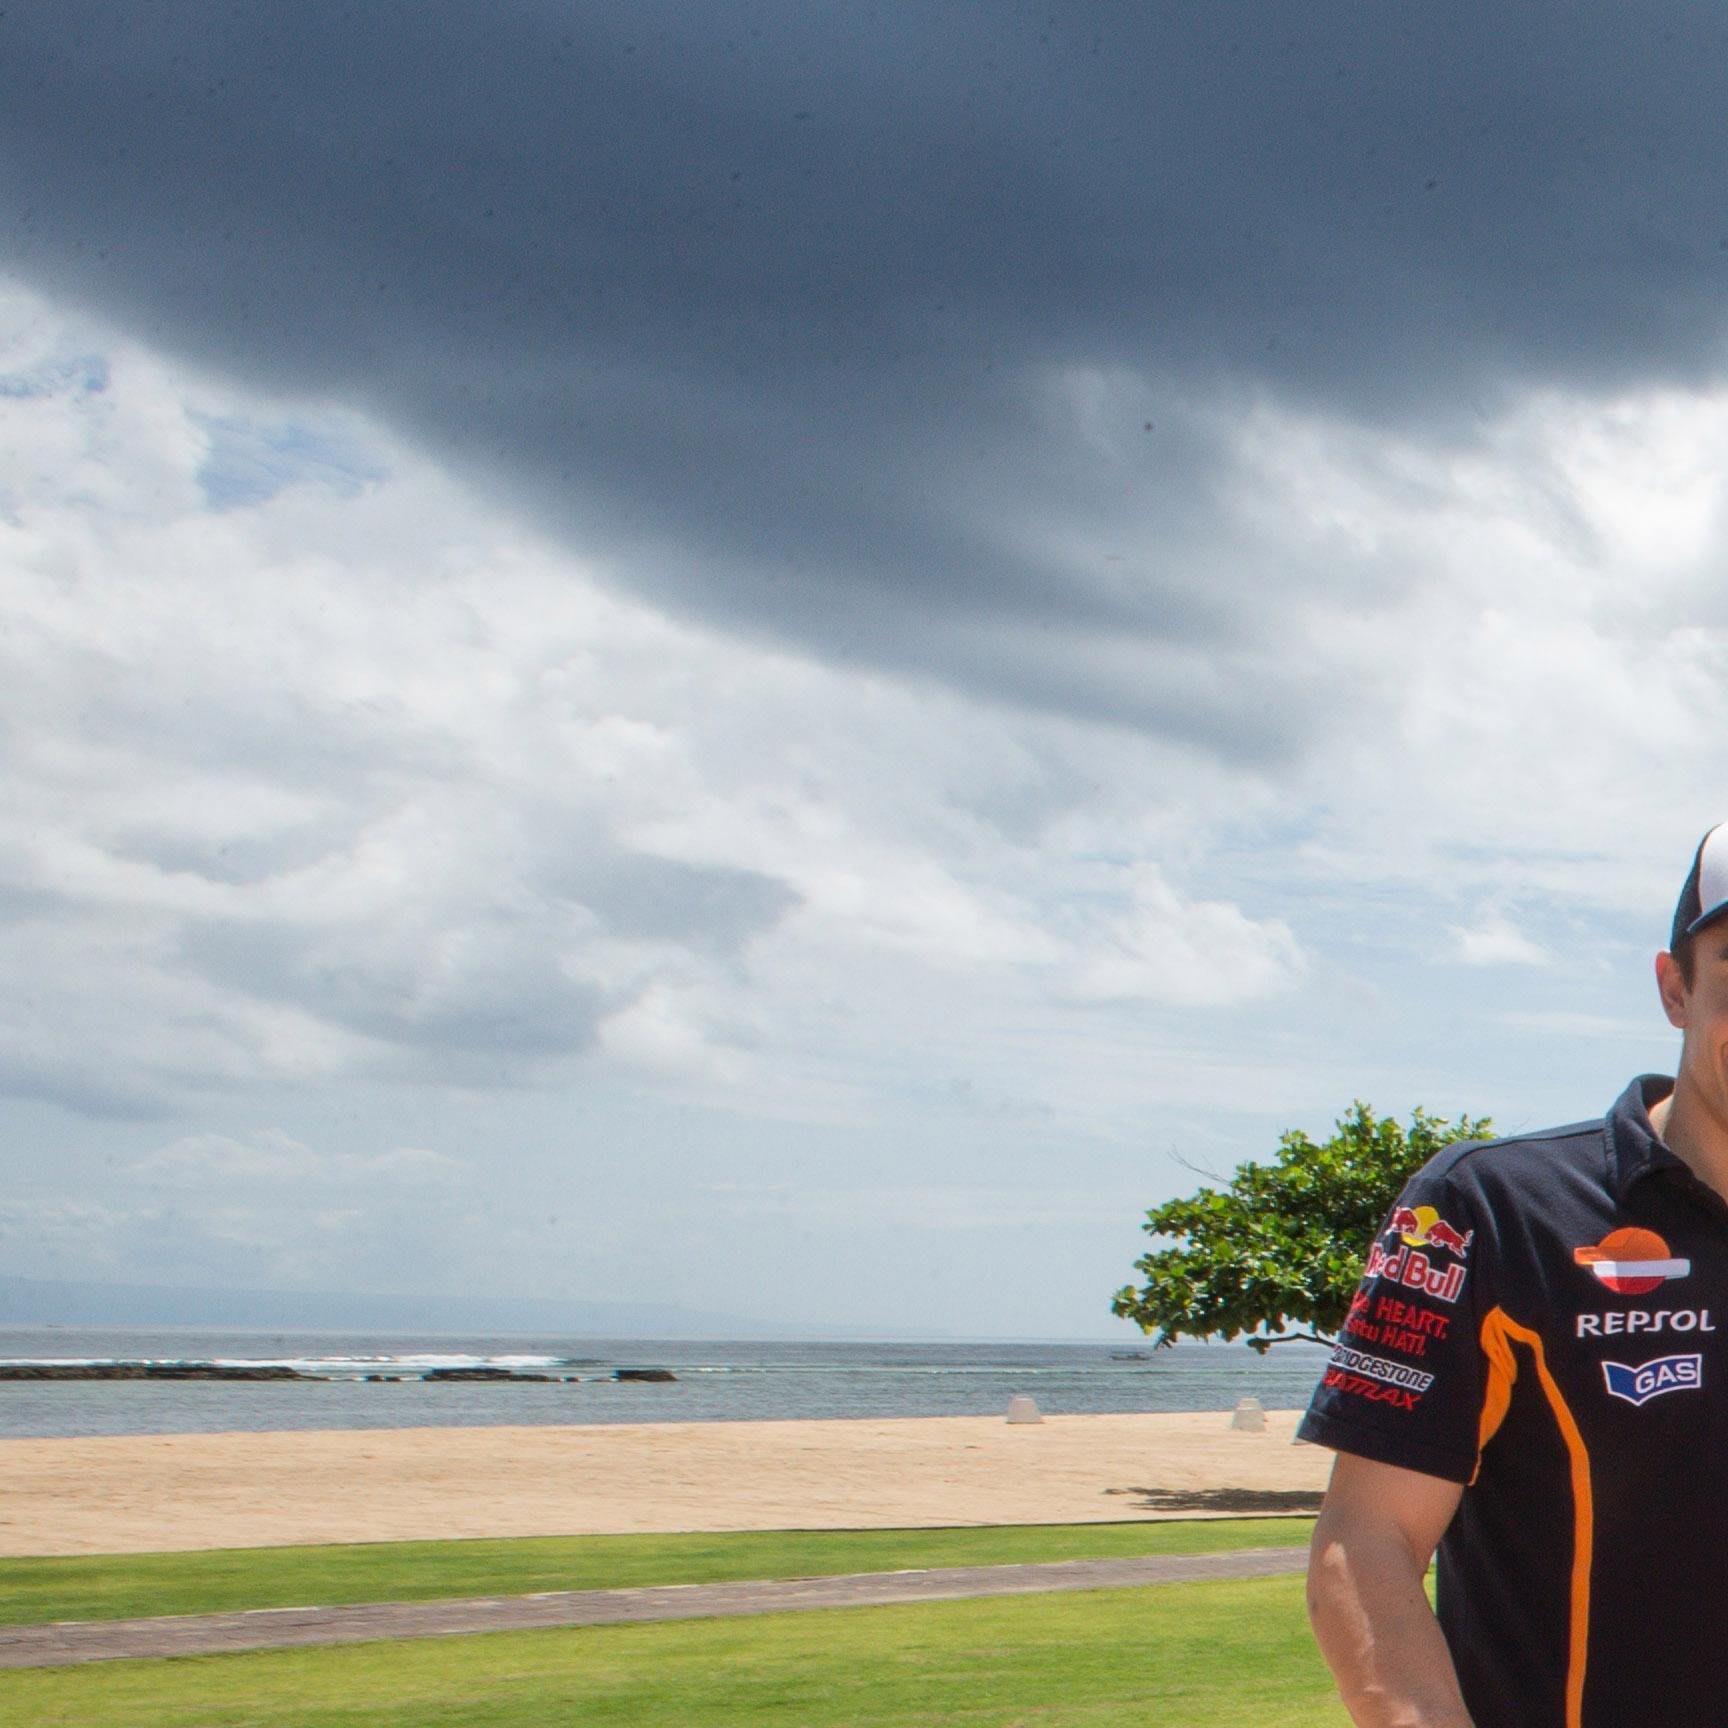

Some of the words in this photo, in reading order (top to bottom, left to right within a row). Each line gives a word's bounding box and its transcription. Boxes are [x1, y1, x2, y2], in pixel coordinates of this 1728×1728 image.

[1401, 1251, 1467, 1304] Bull
[1576, 1309, 1716, 1338] REPSOL
[1634, 1361, 1699, 1394] GAS
